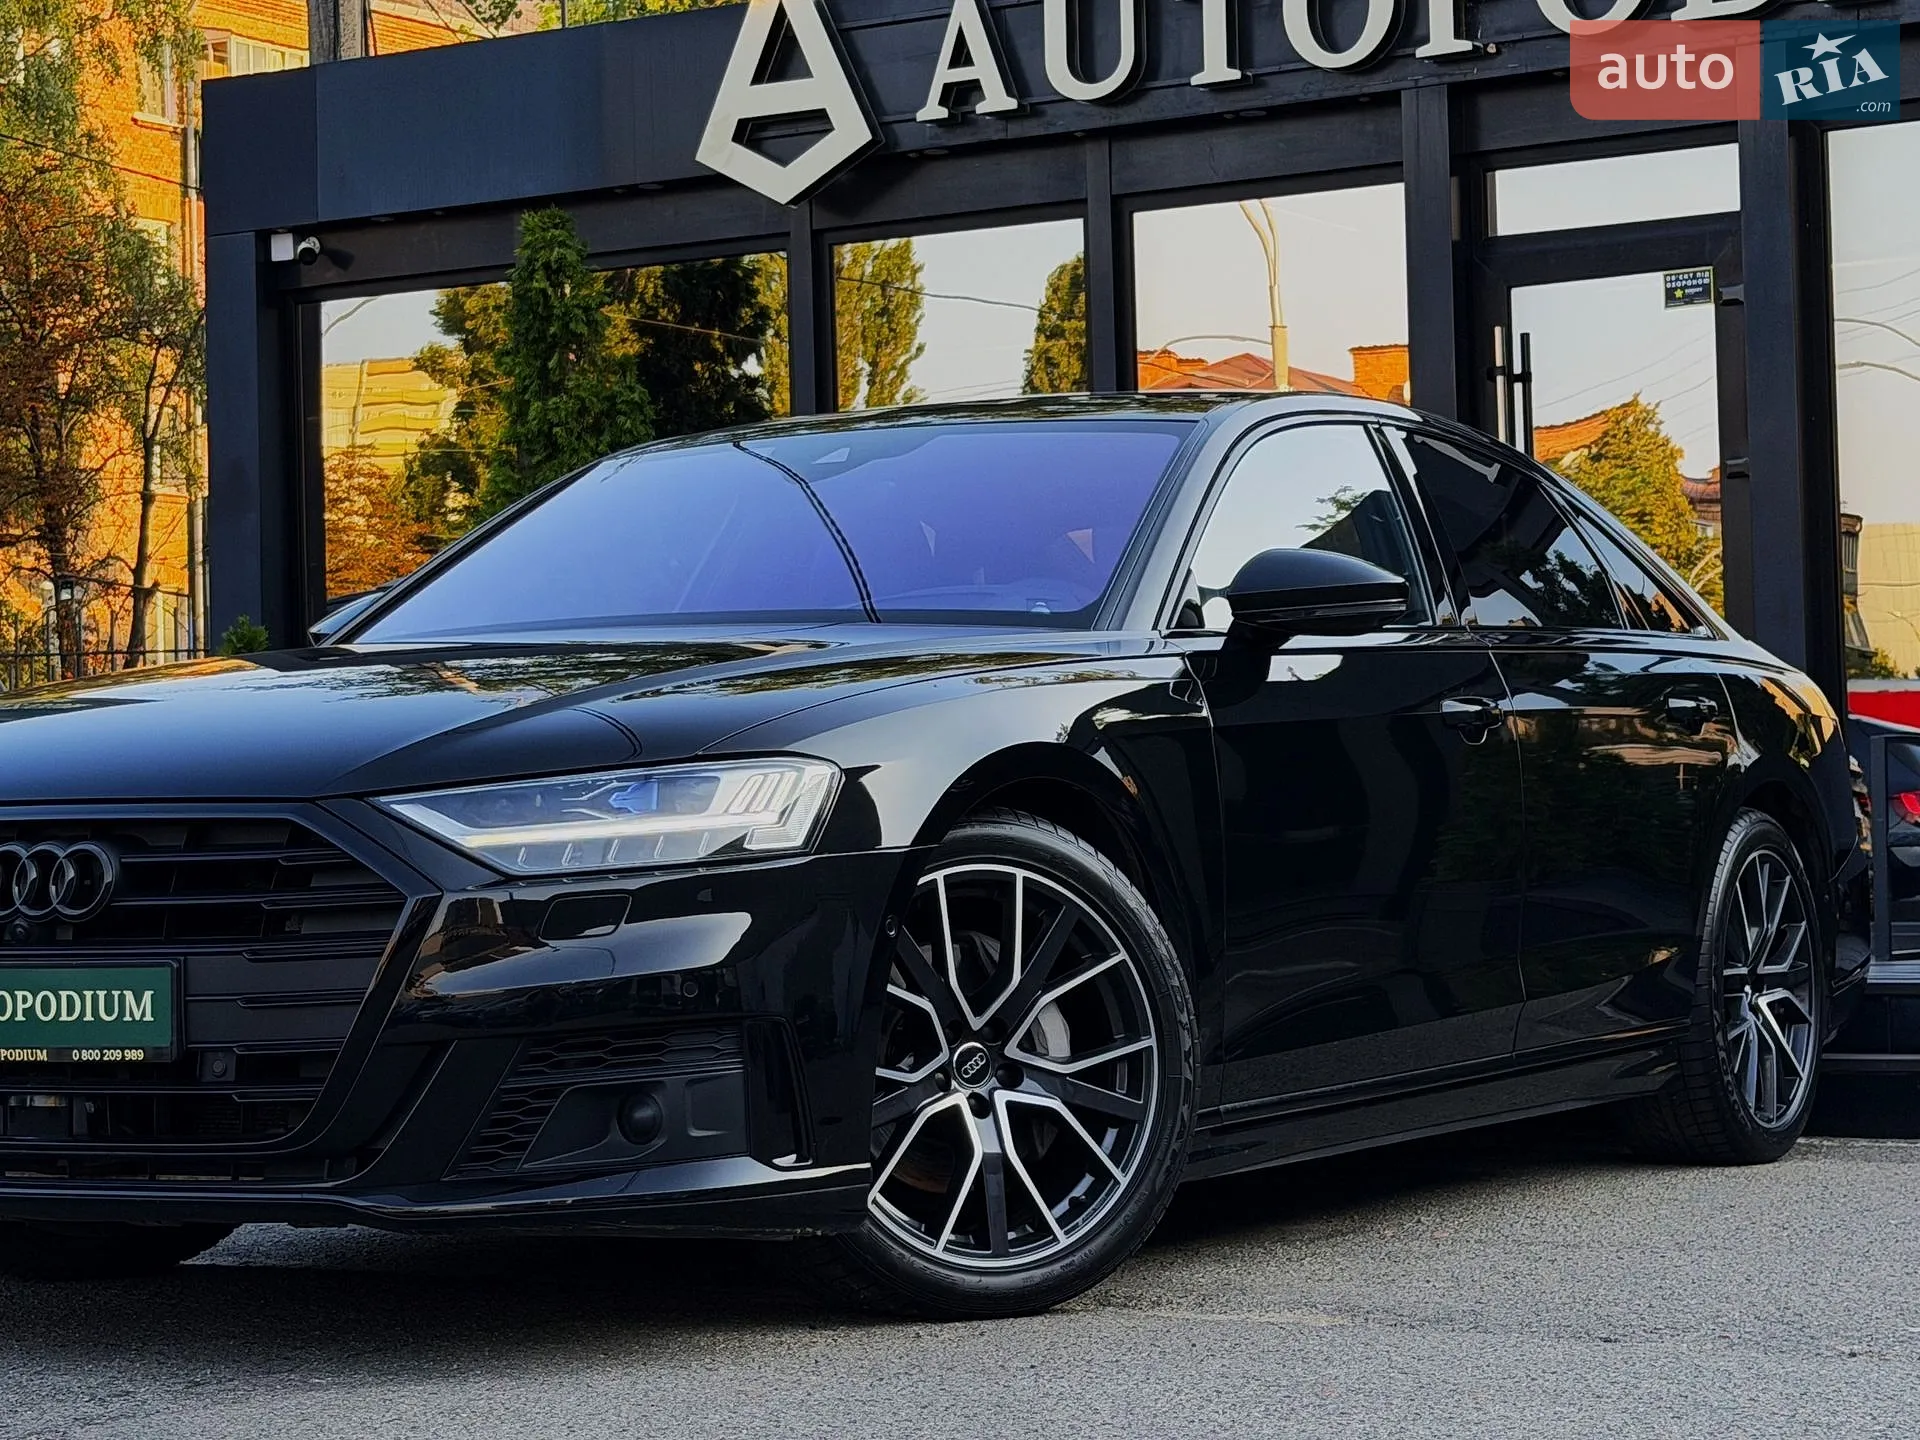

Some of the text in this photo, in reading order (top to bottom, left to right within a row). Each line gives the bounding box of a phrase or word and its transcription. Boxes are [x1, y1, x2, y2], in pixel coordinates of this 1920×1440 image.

[0, 990, 154, 1021] OPODIUM
[0, 1049, 47, 1061] PODIUM
[72, 1049, 144, 1061] 0 800 209 989
